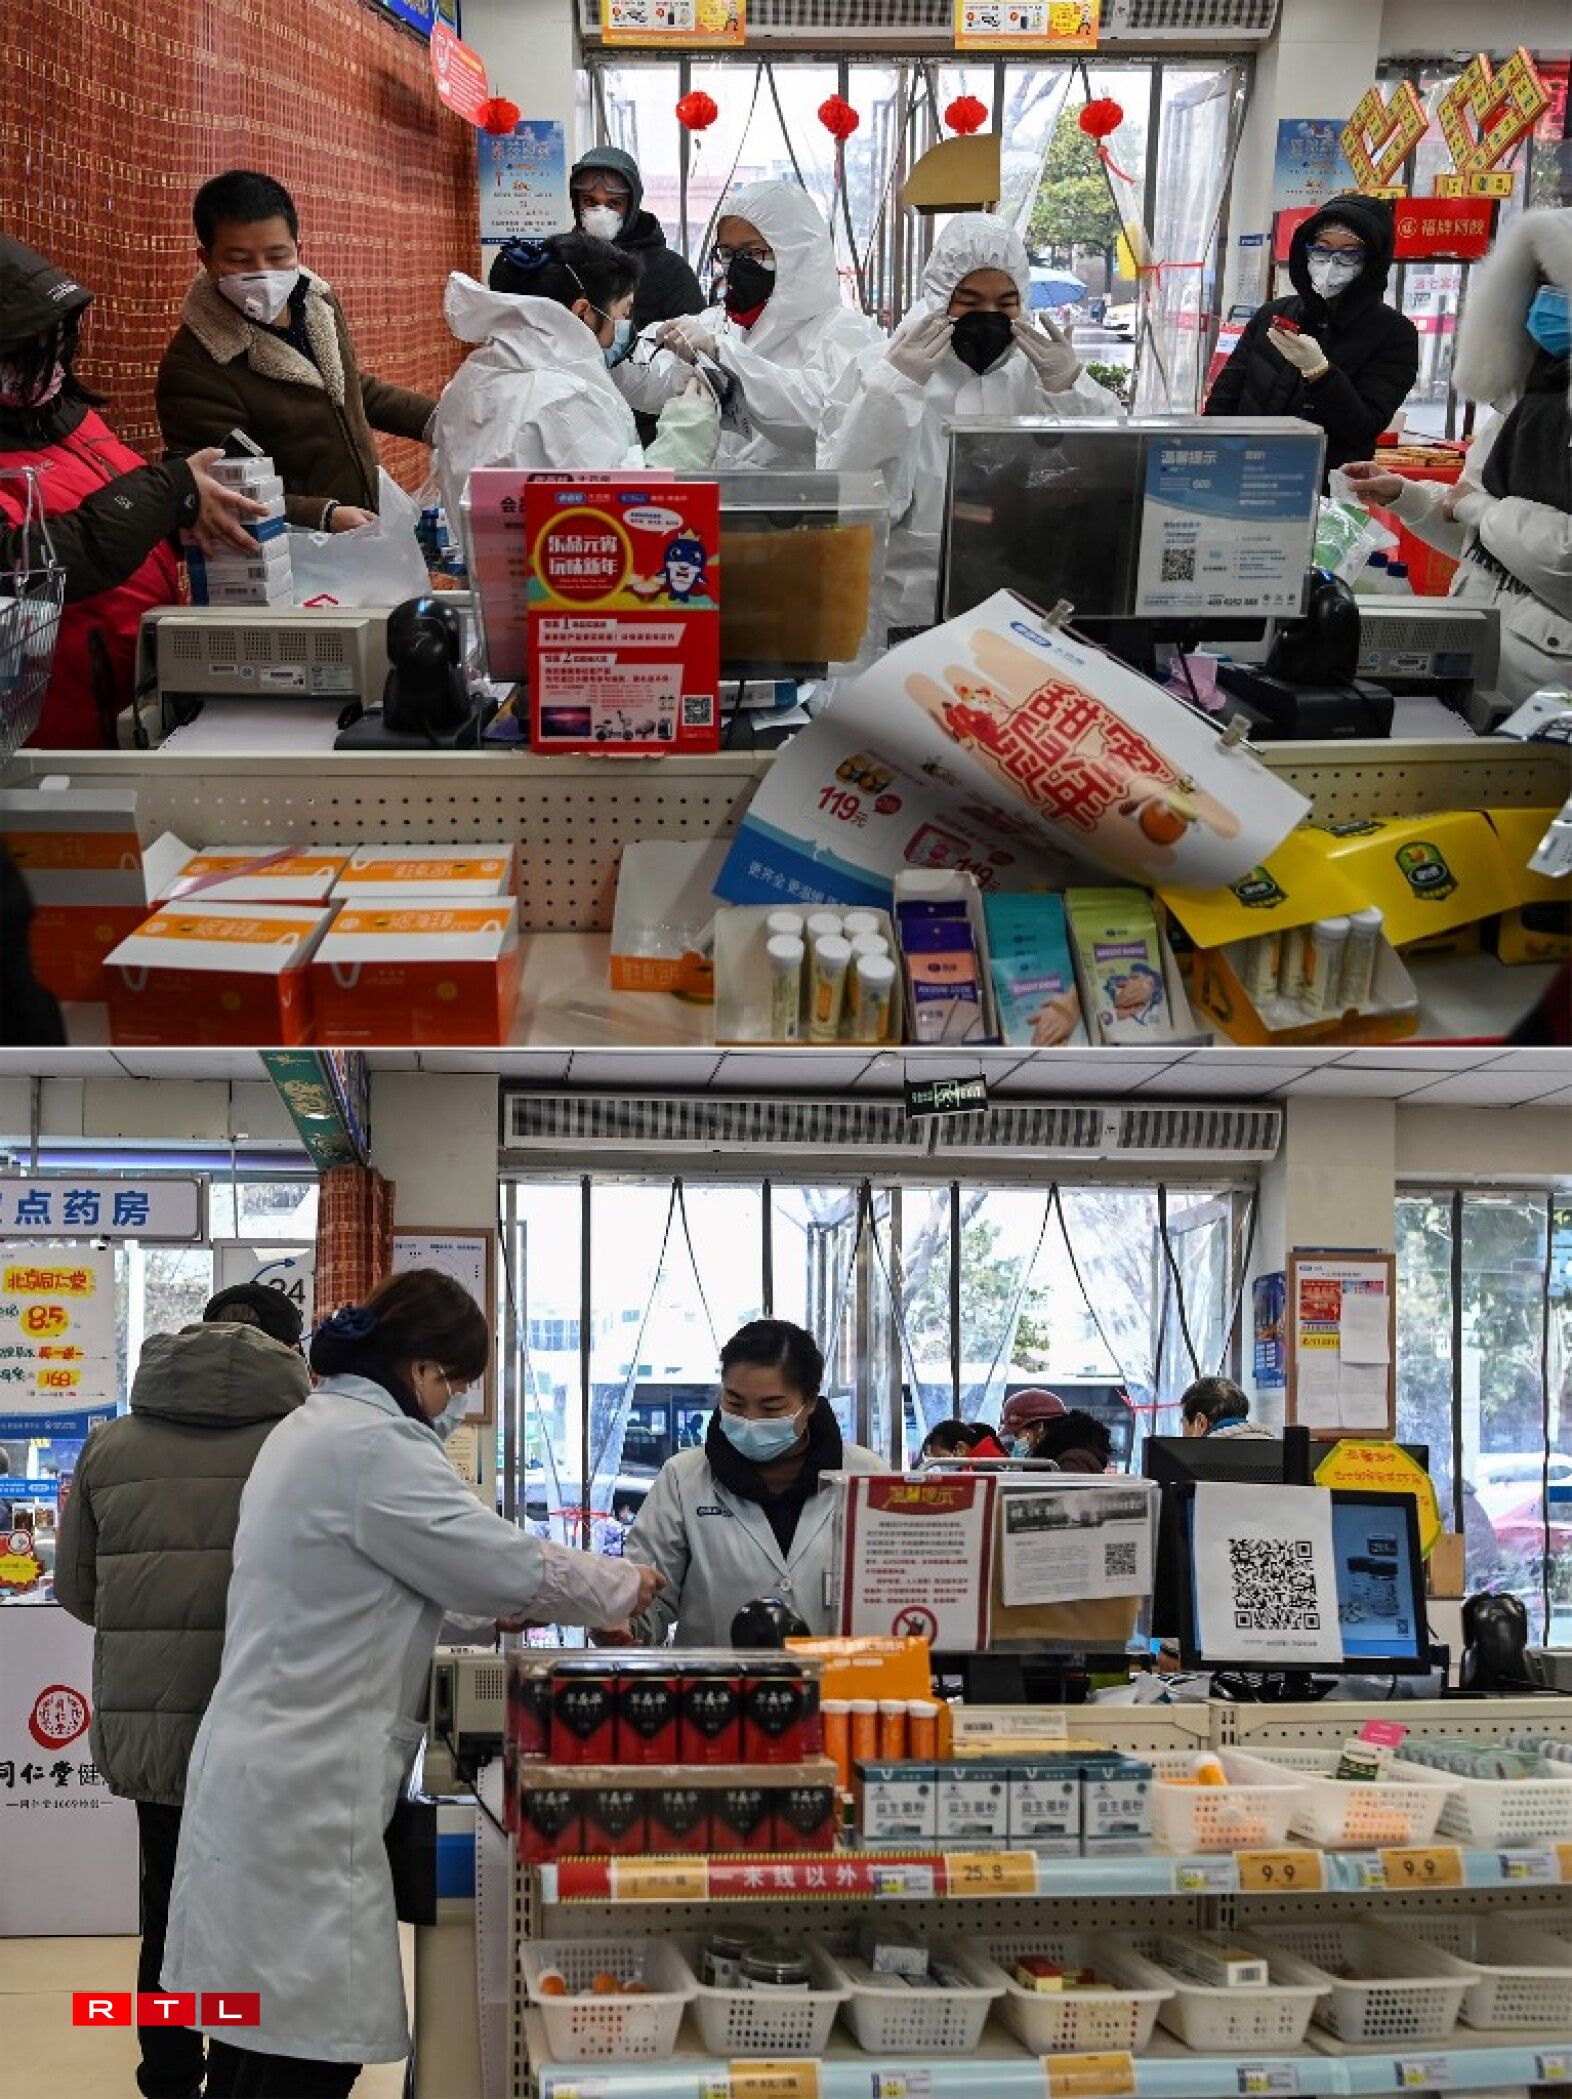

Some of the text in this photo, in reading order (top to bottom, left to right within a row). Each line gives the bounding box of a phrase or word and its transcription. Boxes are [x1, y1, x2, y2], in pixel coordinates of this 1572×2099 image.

[1422, 219, 1484, 236] 福牌阿胶
[0, 1189, 151, 1226] 点药房
[8, 1269, 88, 1290] 北京同仁堂
[28, 1305, 64, 1329] 8.5
[0, 1760, 106, 1788] 同仁堂健
[1261, 1864, 1296, 1883] 9.9
[1402, 1859, 1436, 1877] 9.9
